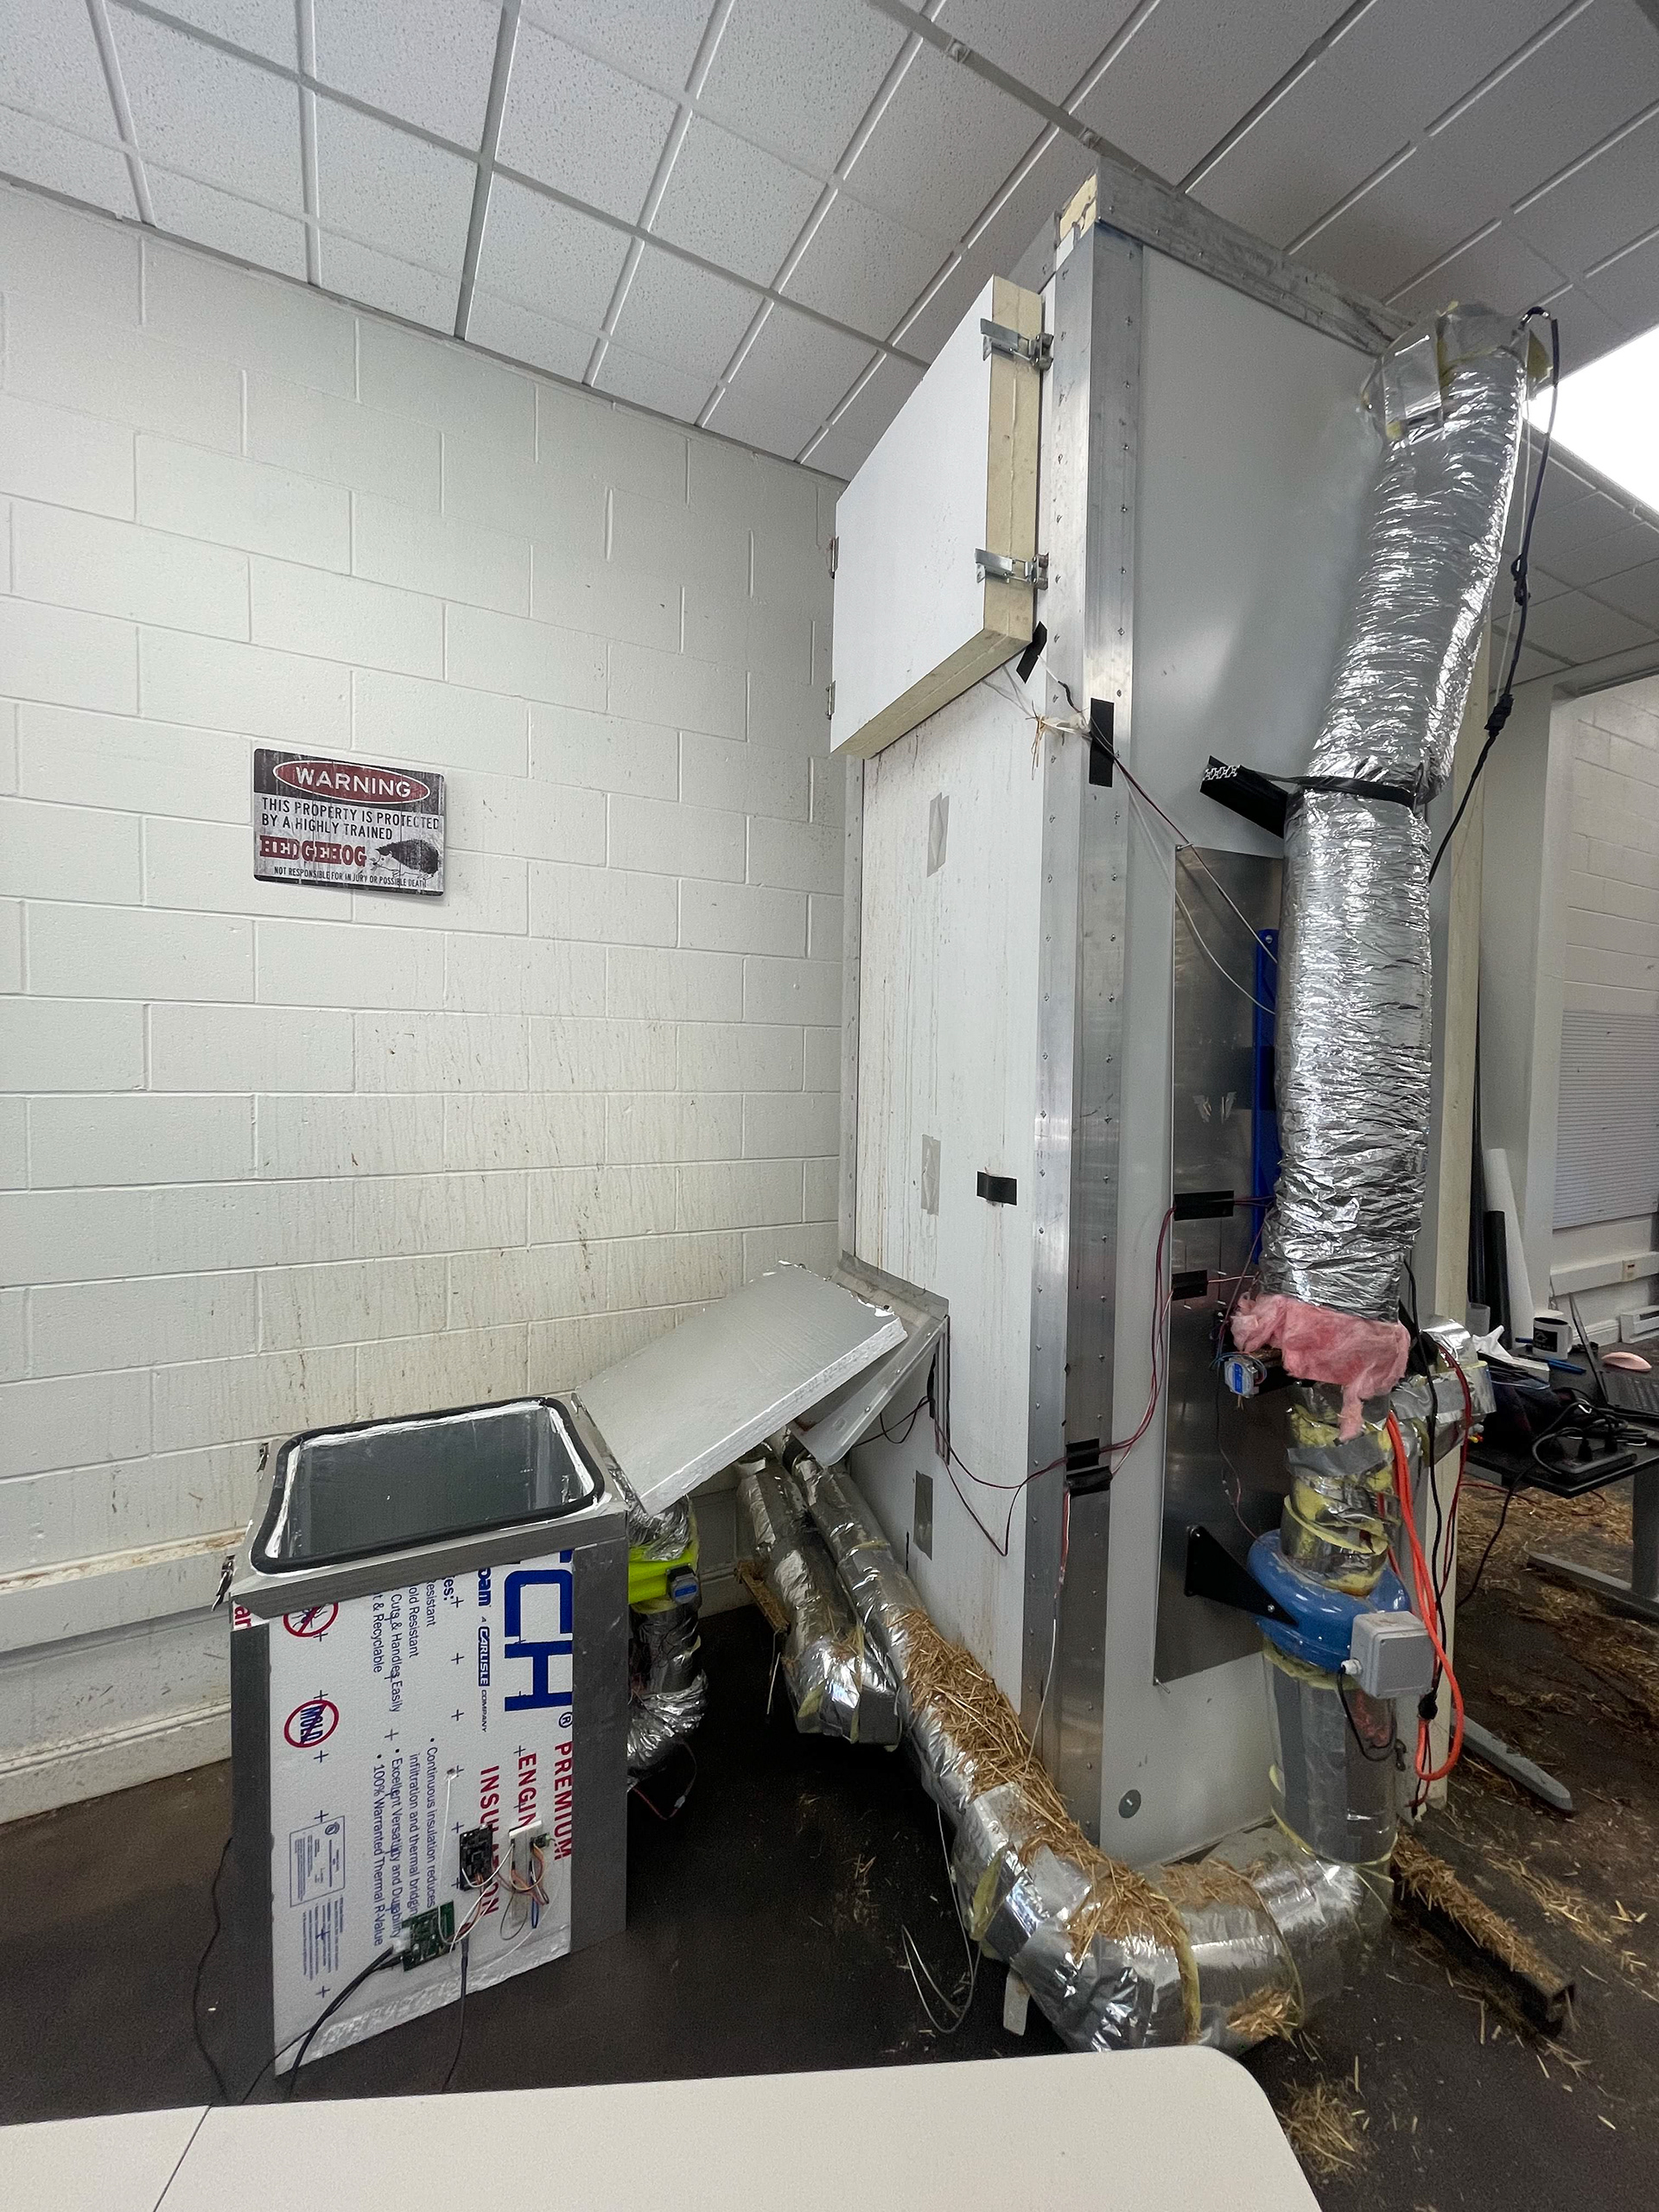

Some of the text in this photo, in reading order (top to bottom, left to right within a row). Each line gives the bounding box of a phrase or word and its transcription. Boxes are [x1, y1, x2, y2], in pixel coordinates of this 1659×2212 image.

[296, 766, 410, 798] WARNING
[262, 797, 439, 830] THIS PROPERTY IS PROTECTED
[262, 813, 392, 840] BY A HIGHLY TRAINED
[259, 835, 367, 867] HEDGEHOG
[274, 866, 287, 875] NOT
[288, 867, 330, 880] RESPONSIBLE
[331, 872, 343, 880] FOR
[379, 877, 407, 887] POSSIBLE
[408, 879, 426, 888] DEATH
[372, 1602, 385, 1611] &
[371, 1614, 385, 1673] Recyclable
[390, 1593, 404, 1713] Cuts & Handles Easily
[409, 1605, 420, 1658] Resistant
[479, 1625, 490, 1686] CARLISLE
[300, 1705, 323, 1743] MOLD
[391, 1758, 404, 1808] Excellent
[409, 1752, 421, 1809] infiltration
[554, 1740, 573, 1861] PREMIUM
[390, 1808, 404, 1861] Versatility
[409, 1811, 420, 1833] and
[426, 1747, 438, 1908] Continuous insulation reduces
[373, 1764, 386, 1947] 100% Warranted Thermal R-Value
[391, 1865, 403, 1885] and
[409, 1834, 421, 1877] thermal
